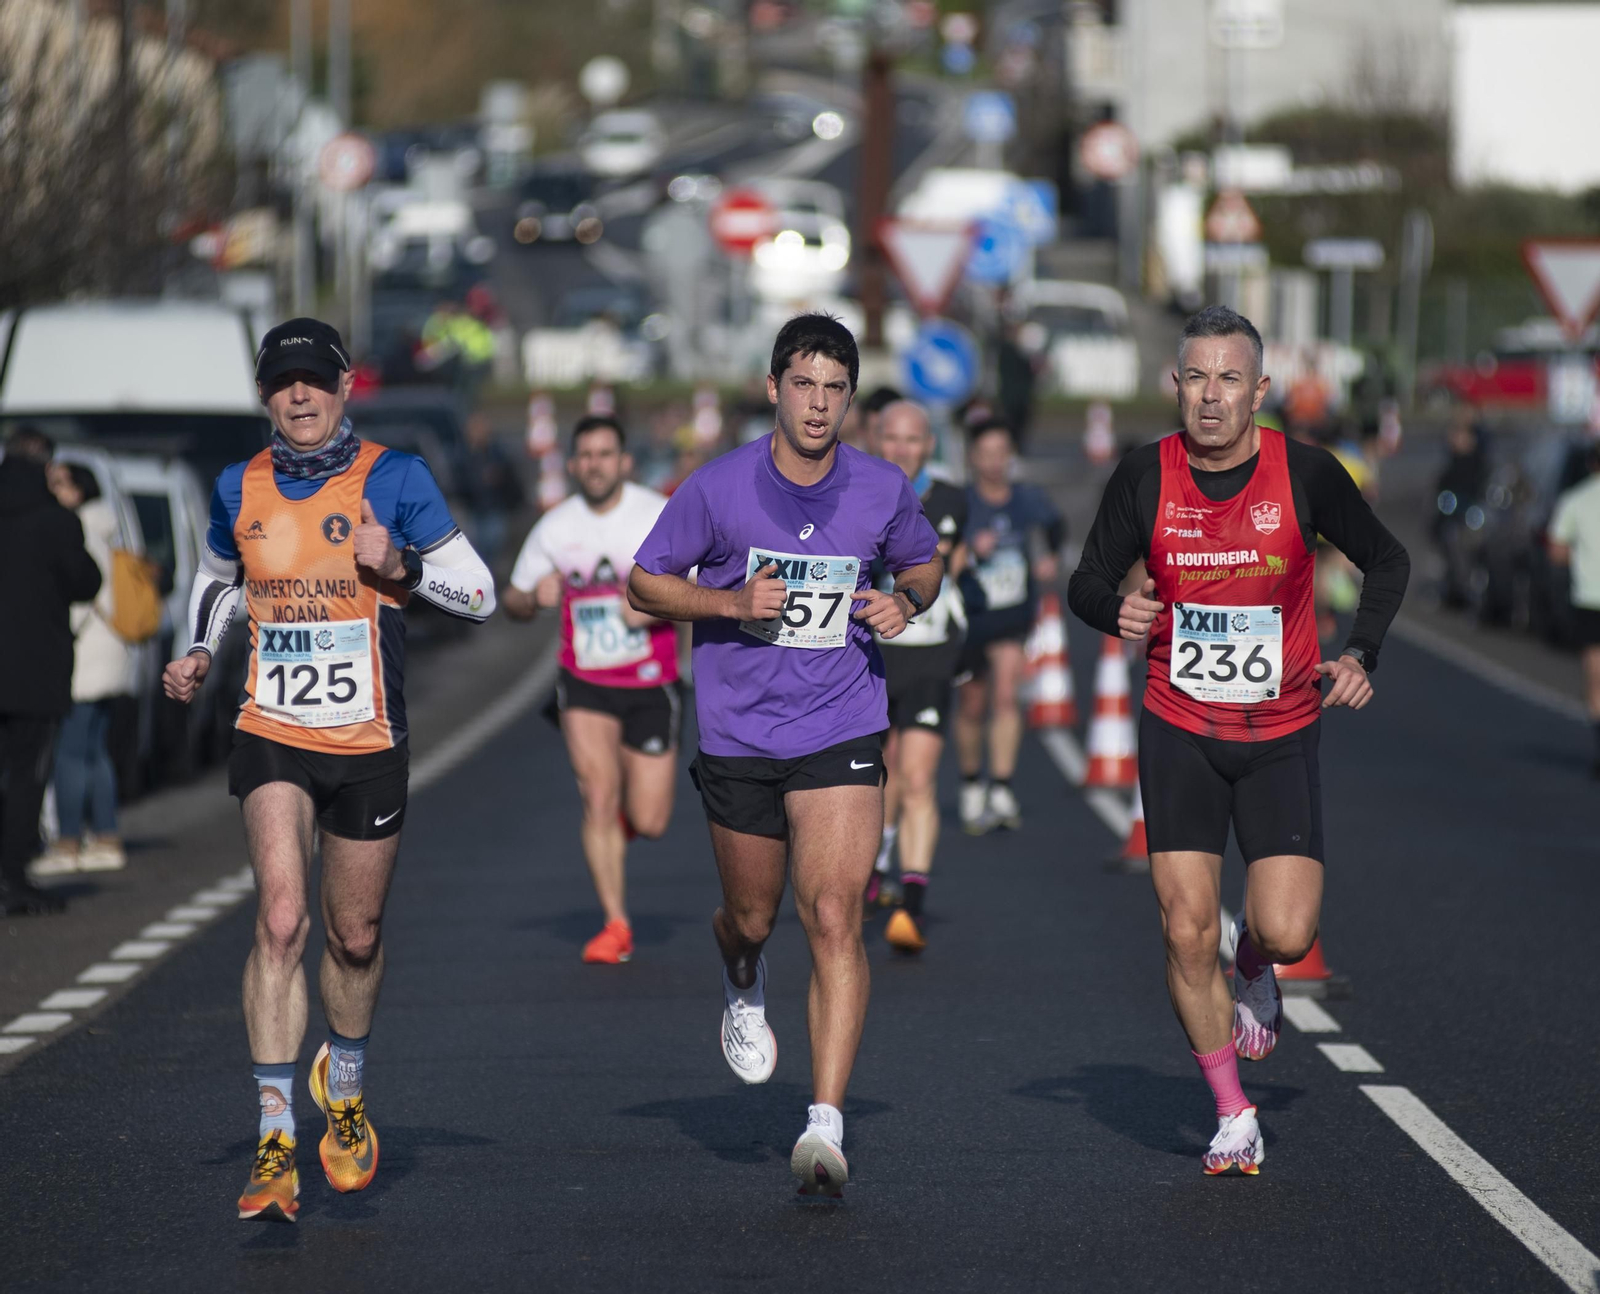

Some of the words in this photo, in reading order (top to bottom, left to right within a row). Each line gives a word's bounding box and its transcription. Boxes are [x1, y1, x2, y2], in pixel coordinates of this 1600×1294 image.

[280, 337, 301, 347] RUN
[1166, 552, 1175, 566] A
[1176, 549, 1259, 567] BOUTUREIRA
[1178, 566, 1231, 585] paraíso
[1235, 558, 1289, 579] natural
[428, 580, 470, 606] adapta
[272, 600, 330, 623] MOAÑA
[768, 591, 844, 629] 57
[1179, 609, 1228, 633] XXII
[262, 629, 312, 653] XXII
[1176, 640, 1273, 683] 236
[266, 661, 358, 706] 125
